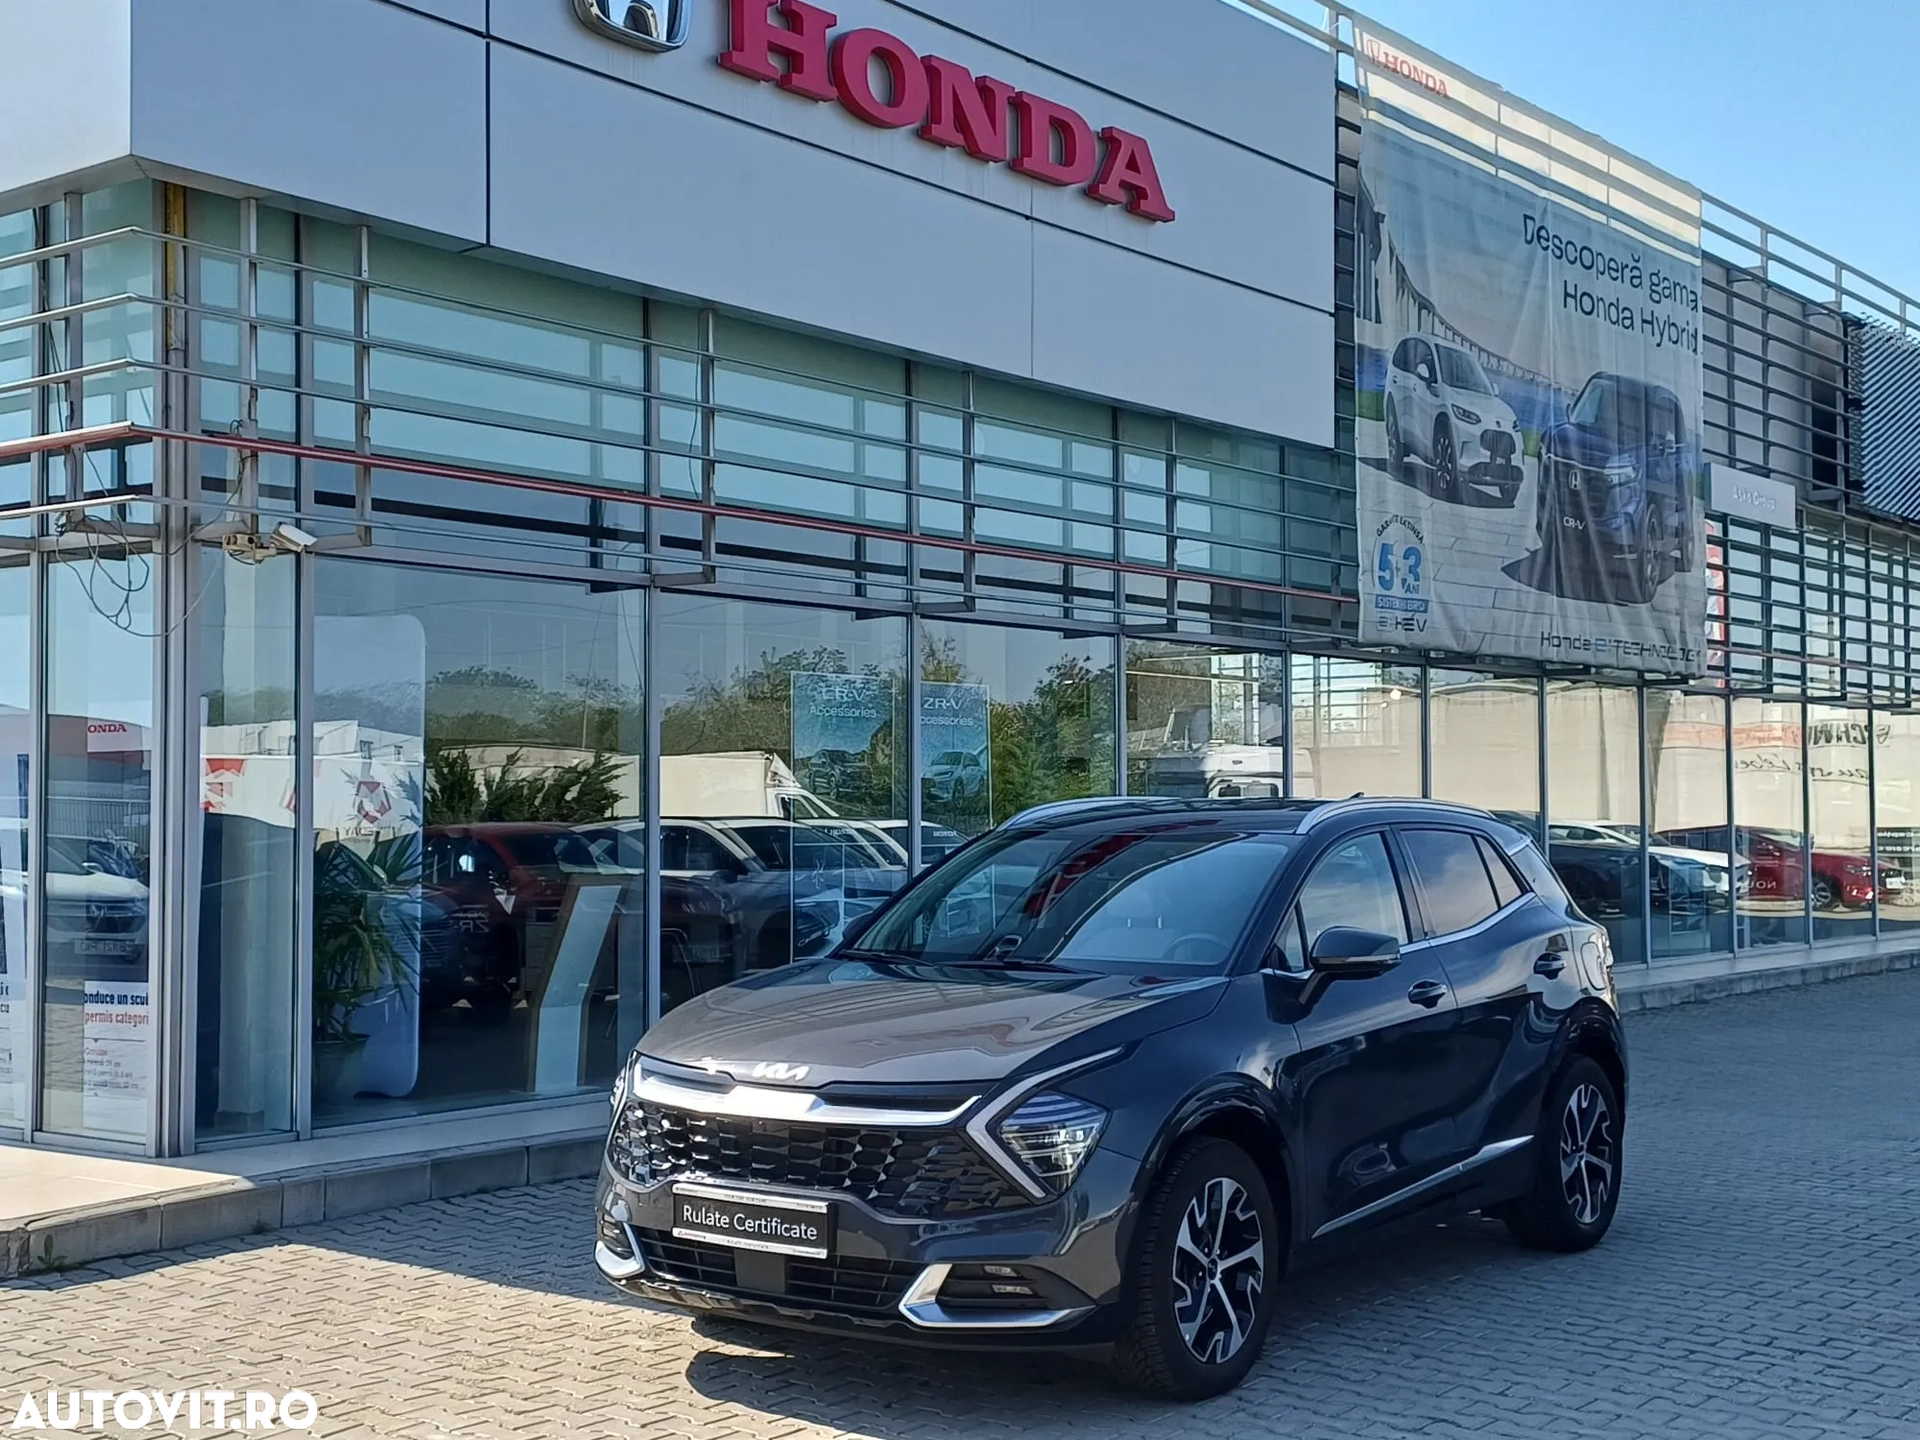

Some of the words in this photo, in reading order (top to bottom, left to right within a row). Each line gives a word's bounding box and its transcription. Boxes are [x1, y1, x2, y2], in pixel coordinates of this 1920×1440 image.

[1383, 51, 1450, 99] HONDA
[717, 0, 1174, 223] HONDA
[1523, 213, 1643, 290] Descoperă
[1649, 269, 1698, 313] gama
[1563, 279, 1635, 331] Honda
[1640, 307, 1698, 355] Hybrid
[1563, 516, 1586, 529] CR-V
[1541, 631, 1591, 651] Honda
[923, 697, 962, 709] ZR-V
[88, 724, 127, 733] ONDA
[920, 716, 974, 726] ccessories
[84, 991, 115, 1005] onduce
[117, 993, 128, 1005] un
[85, 1010, 113, 1025] permis
[683, 1204, 730, 1228] Rulate
[733, 1213, 818, 1241] Certificate
